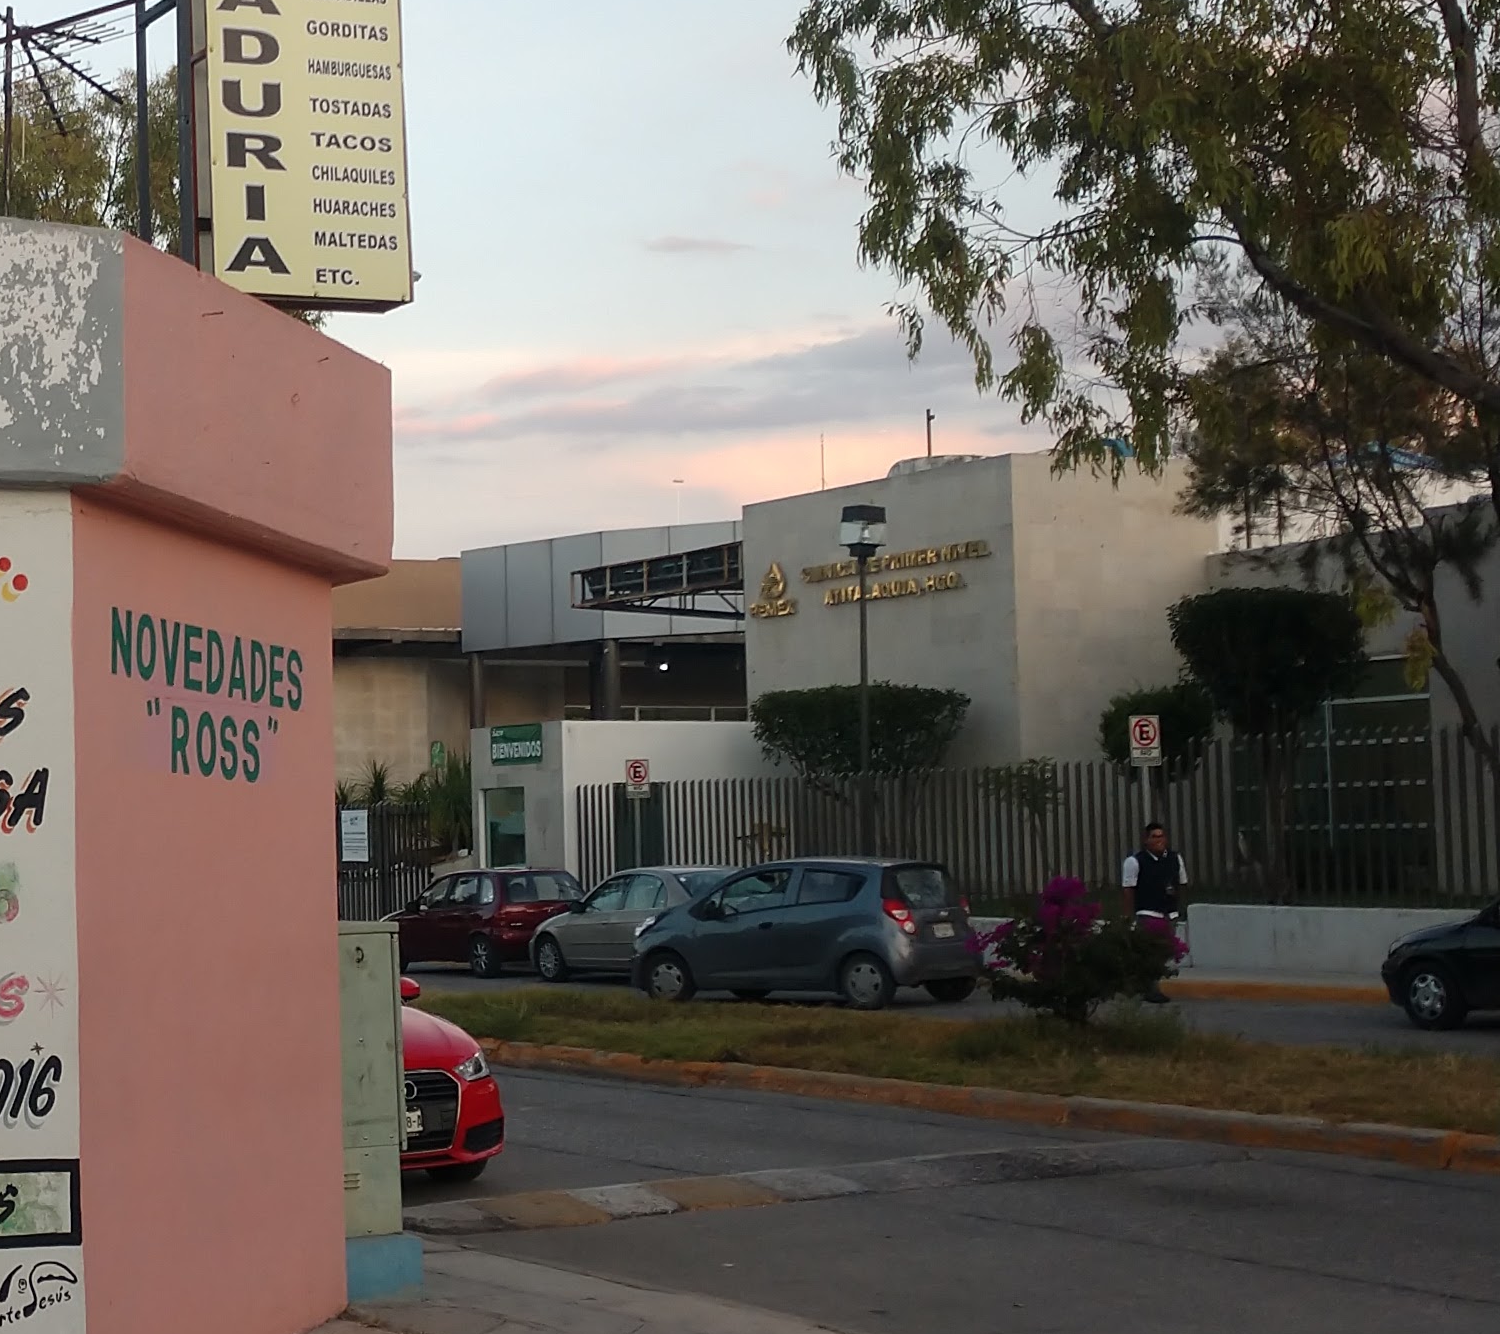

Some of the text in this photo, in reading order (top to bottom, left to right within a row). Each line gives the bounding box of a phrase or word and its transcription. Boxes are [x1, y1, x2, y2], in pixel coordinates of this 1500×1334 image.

[306, 20, 389, 42] GORDITAS
[308, 58, 392, 81] HAMBURGUESAS
[309, 98, 392, 118] TOSTADAS
[311, 132, 393, 153] TACOS
[312, 165, 396, 186] CHILAQUILES
[313, 198, 397, 218] HUARACHES
[314, 231, 399, 251] MALTEDAS
[315, 268, 361, 286] ETC.
[111, 607, 303, 712] NOVEDADES
[492, 740, 541, 759] BIENVENIDOS
